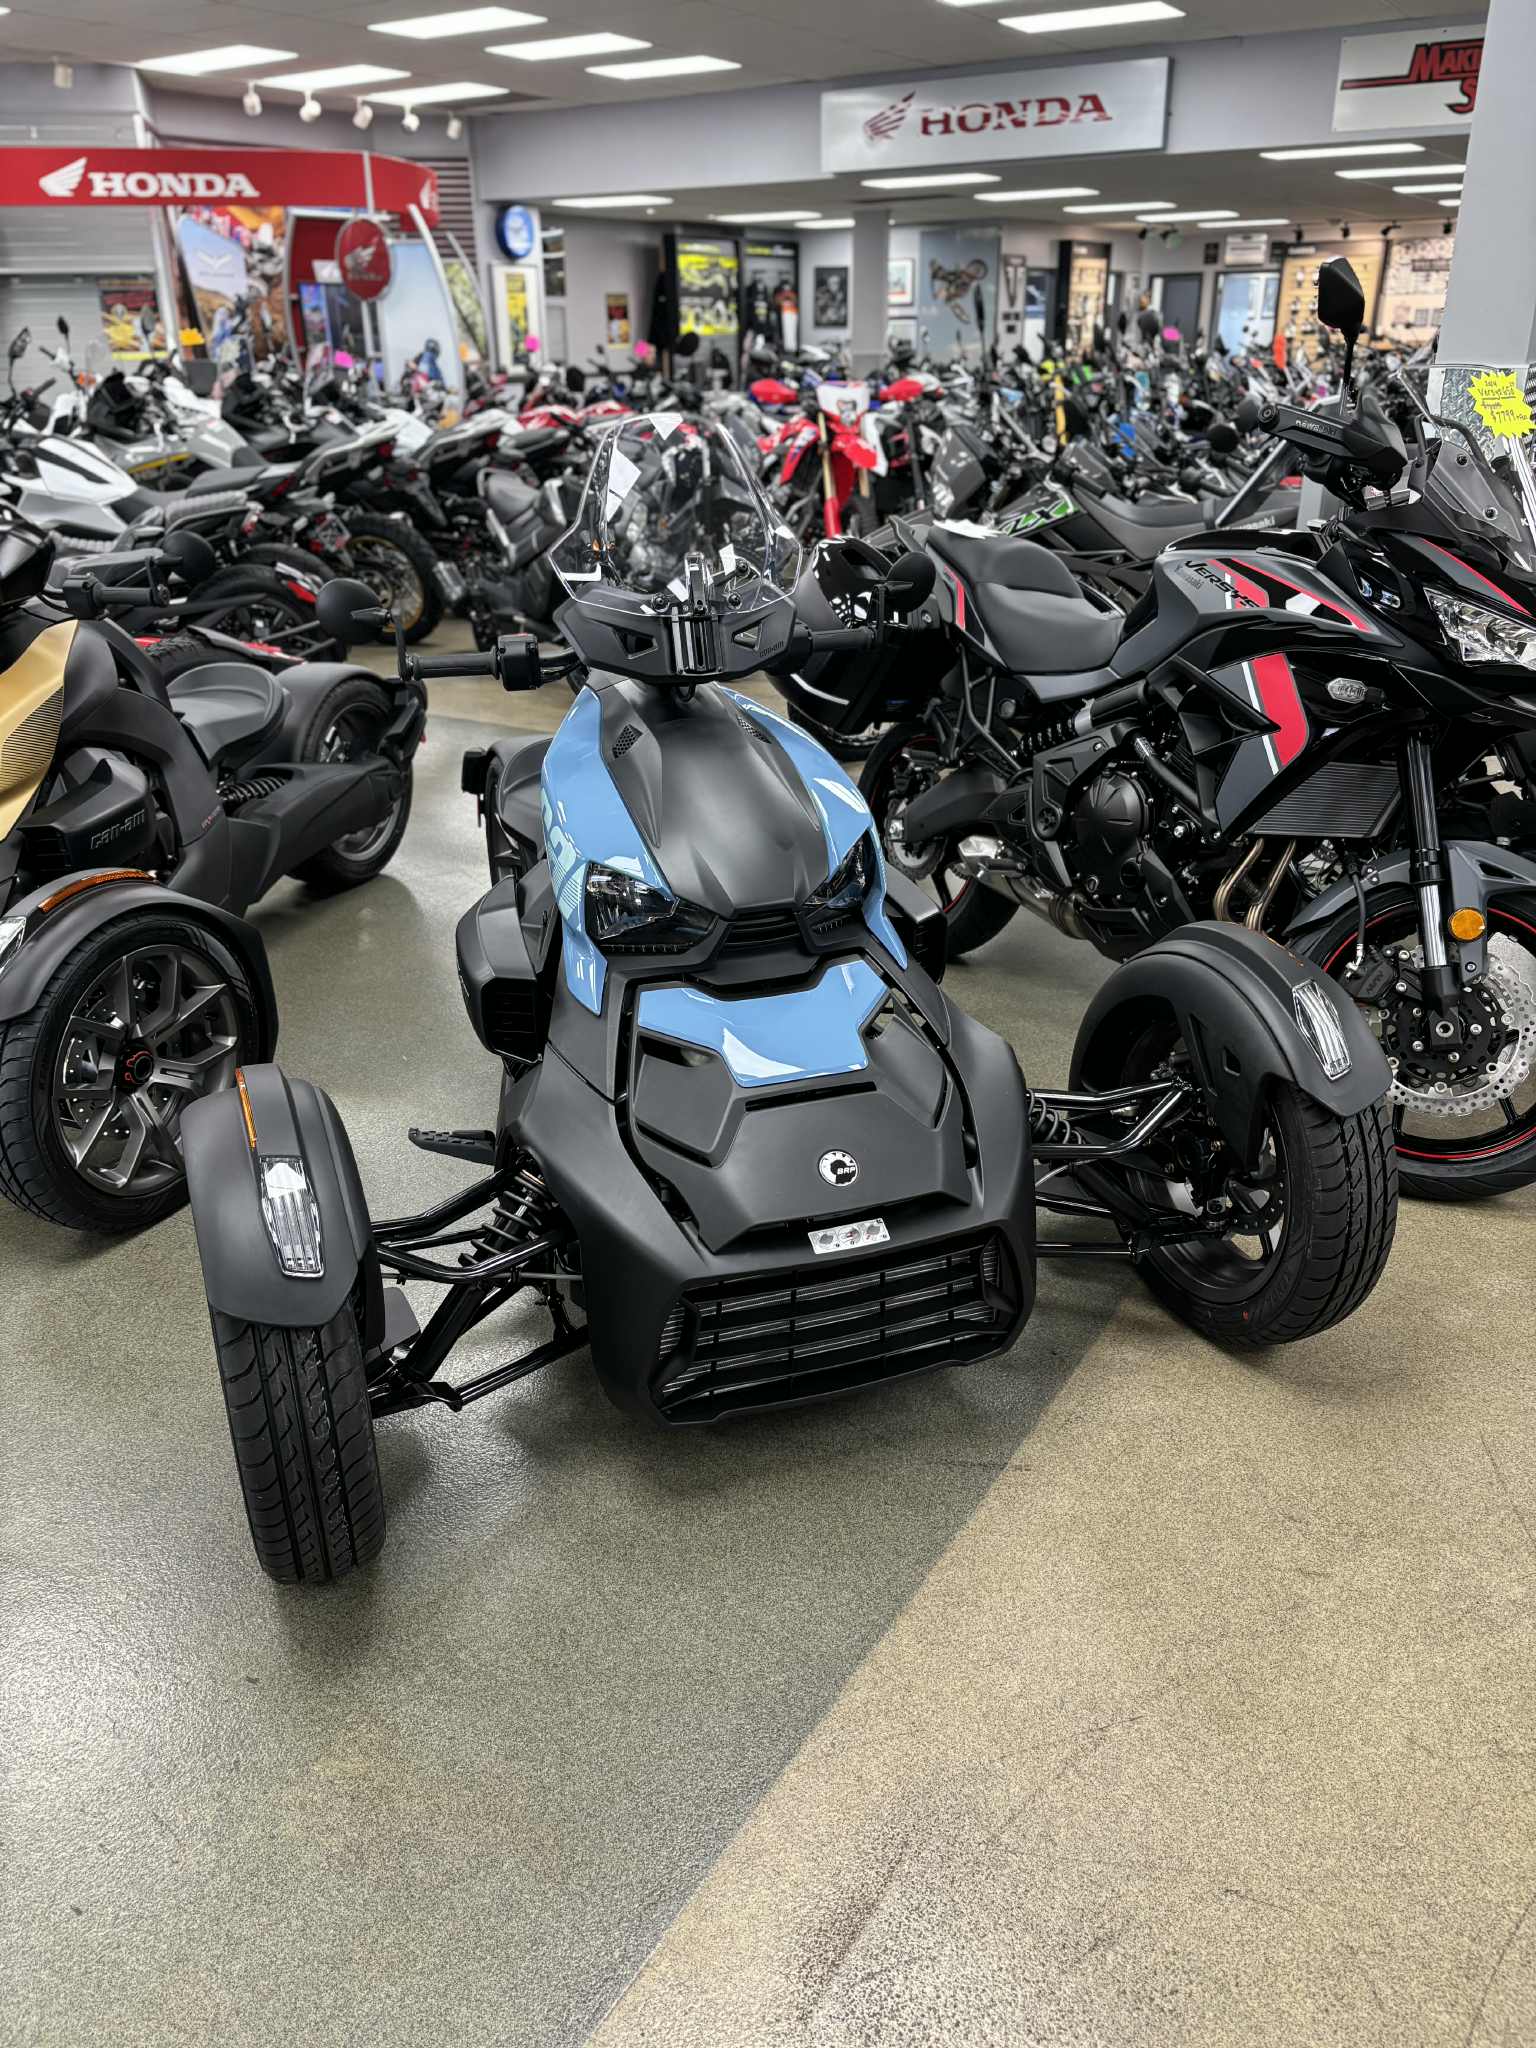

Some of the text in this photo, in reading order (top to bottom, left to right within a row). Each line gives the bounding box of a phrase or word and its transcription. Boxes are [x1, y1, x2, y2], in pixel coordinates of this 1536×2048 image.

[920, 93, 1113, 136] HONDA
[88, 171, 261, 198] HONDA
[1184, 559, 1261, 608] VERSYS
[836, 1166, 856, 1175] BRP
